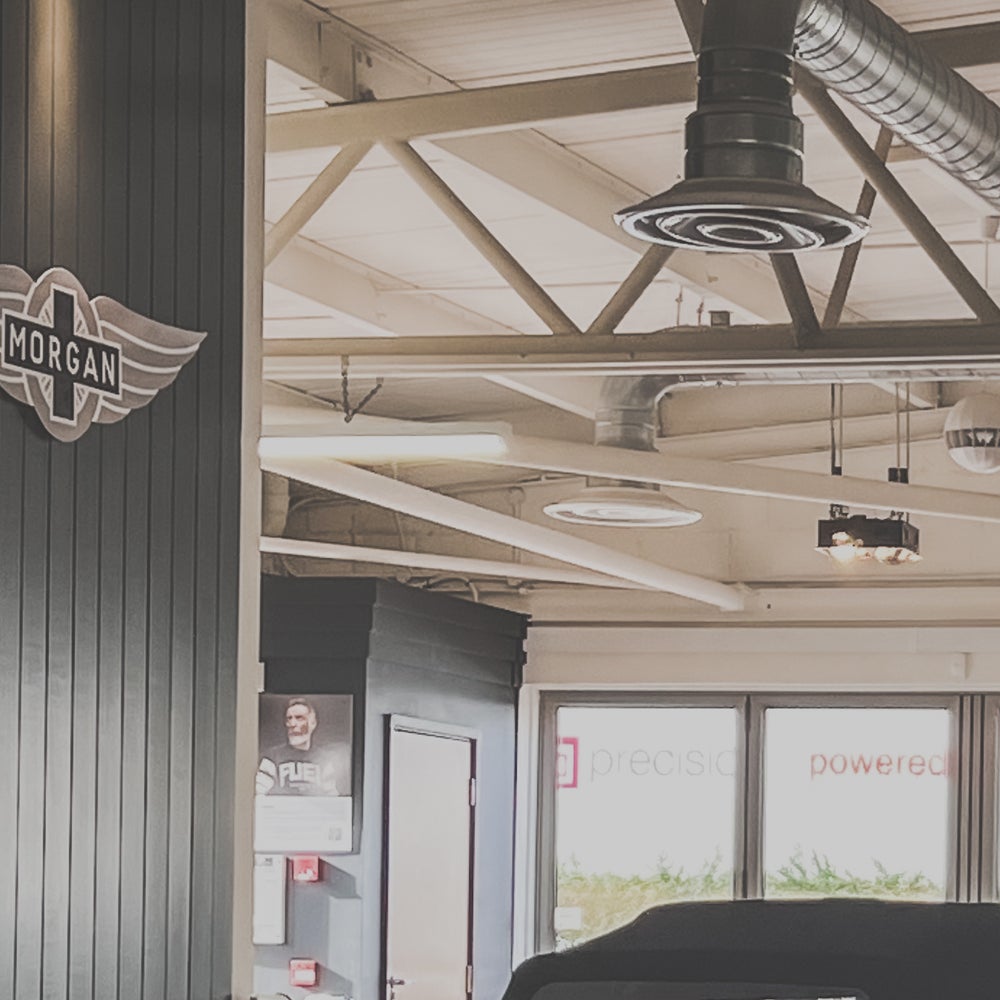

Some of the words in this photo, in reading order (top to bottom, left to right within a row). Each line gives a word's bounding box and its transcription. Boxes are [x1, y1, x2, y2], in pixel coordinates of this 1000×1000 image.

[9, 322, 116, 387] MORGAN
[590, 748, 737, 783] precisio
[809, 752, 950, 781] powered
